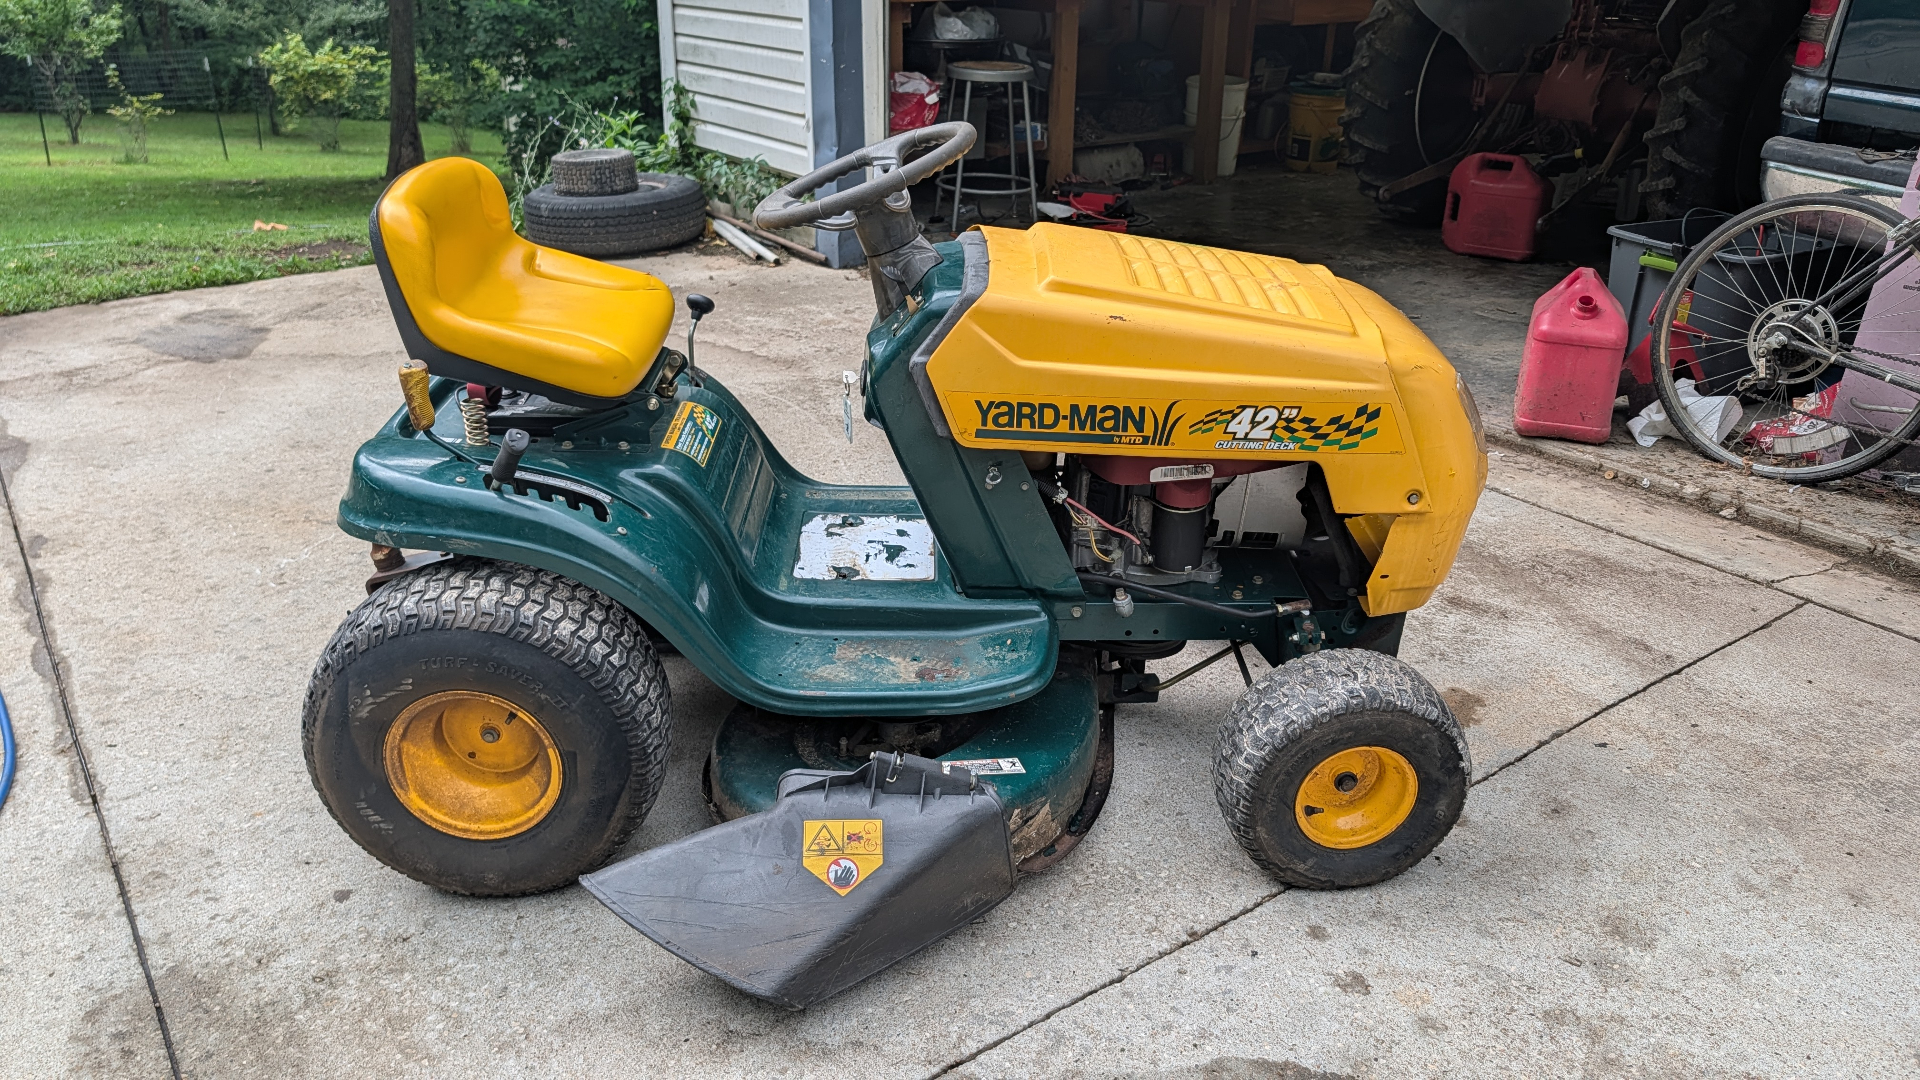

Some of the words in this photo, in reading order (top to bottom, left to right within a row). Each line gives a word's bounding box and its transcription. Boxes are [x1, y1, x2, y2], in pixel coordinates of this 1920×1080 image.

[1113, 435, 1120, 444] by
[1120, 436, 1143, 444] MTD
[1214, 440, 1264, 450] CUTTING
[1265, 441, 1297, 450] DECK
